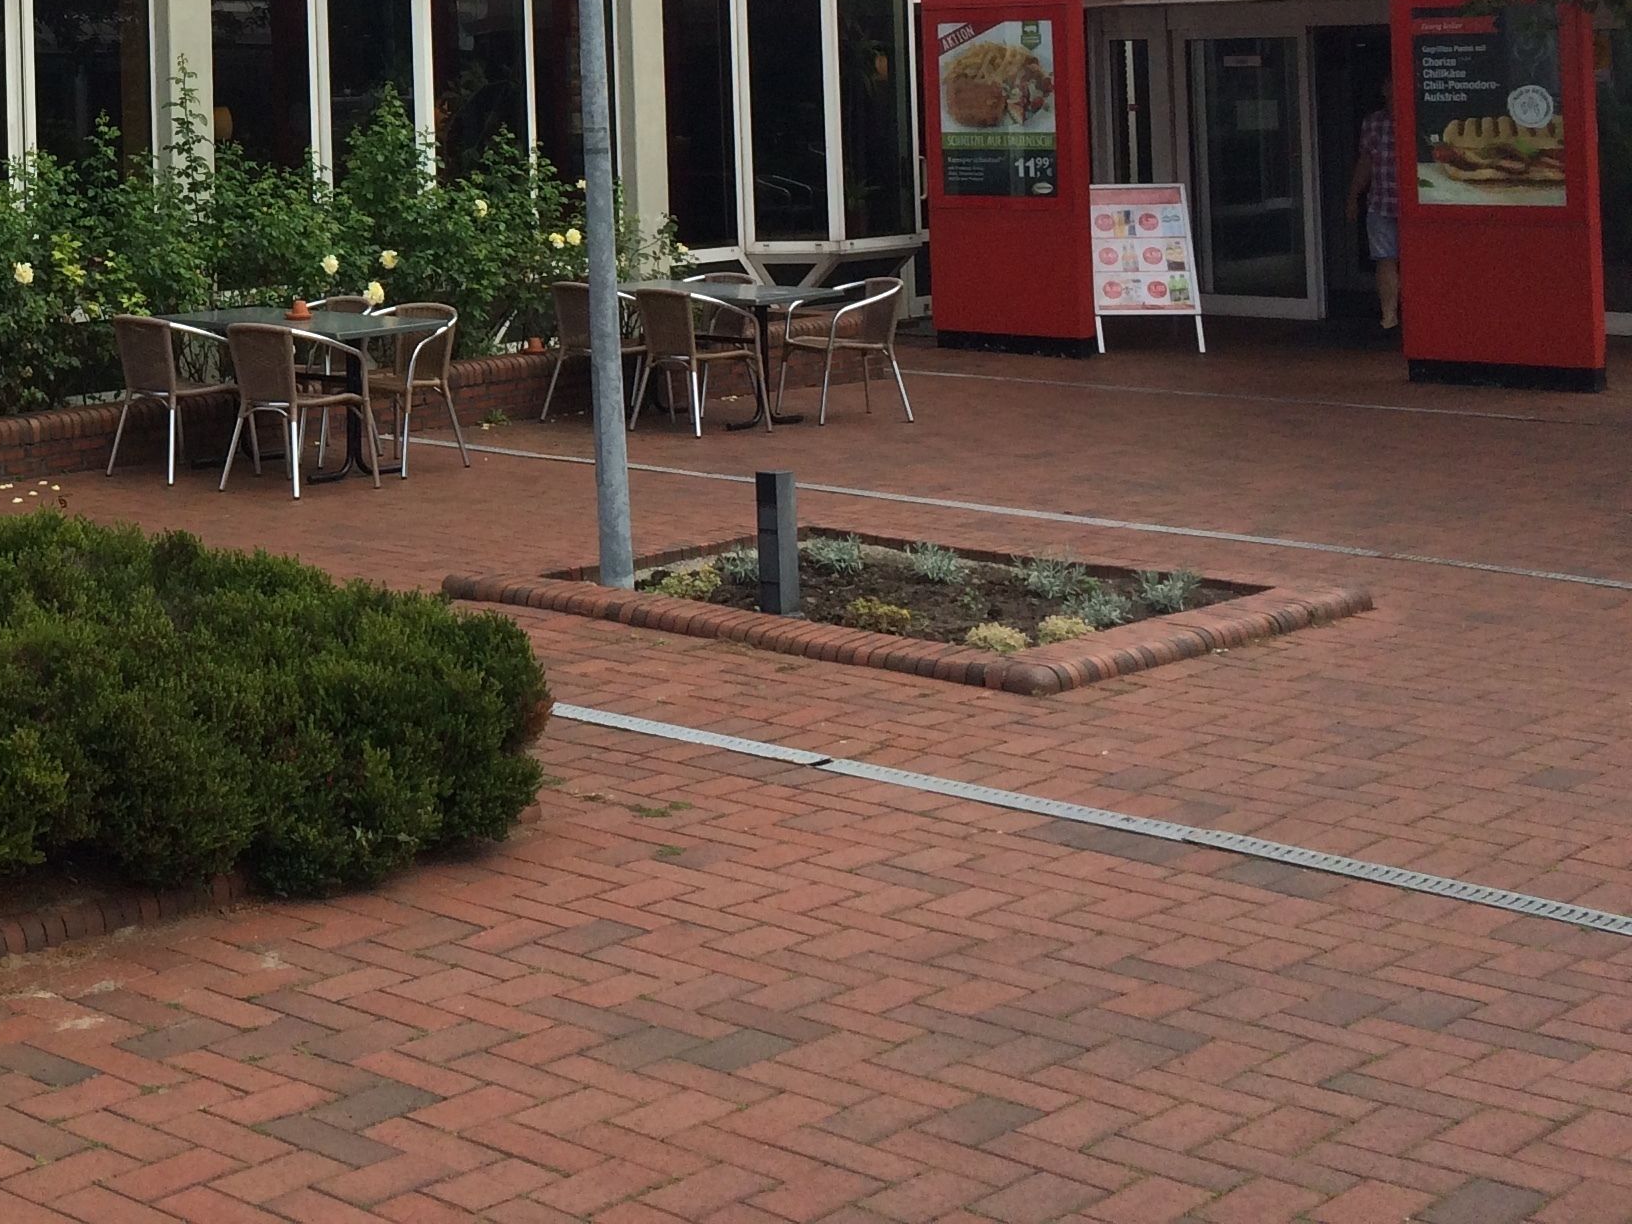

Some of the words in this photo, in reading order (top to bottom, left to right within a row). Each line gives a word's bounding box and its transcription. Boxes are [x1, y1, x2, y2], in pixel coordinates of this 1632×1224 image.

[941, 24, 976, 51] AKTION
[1422, 57, 1457, 66] Chorizo
[1424, 92, 1468, 102] Aufstrich
